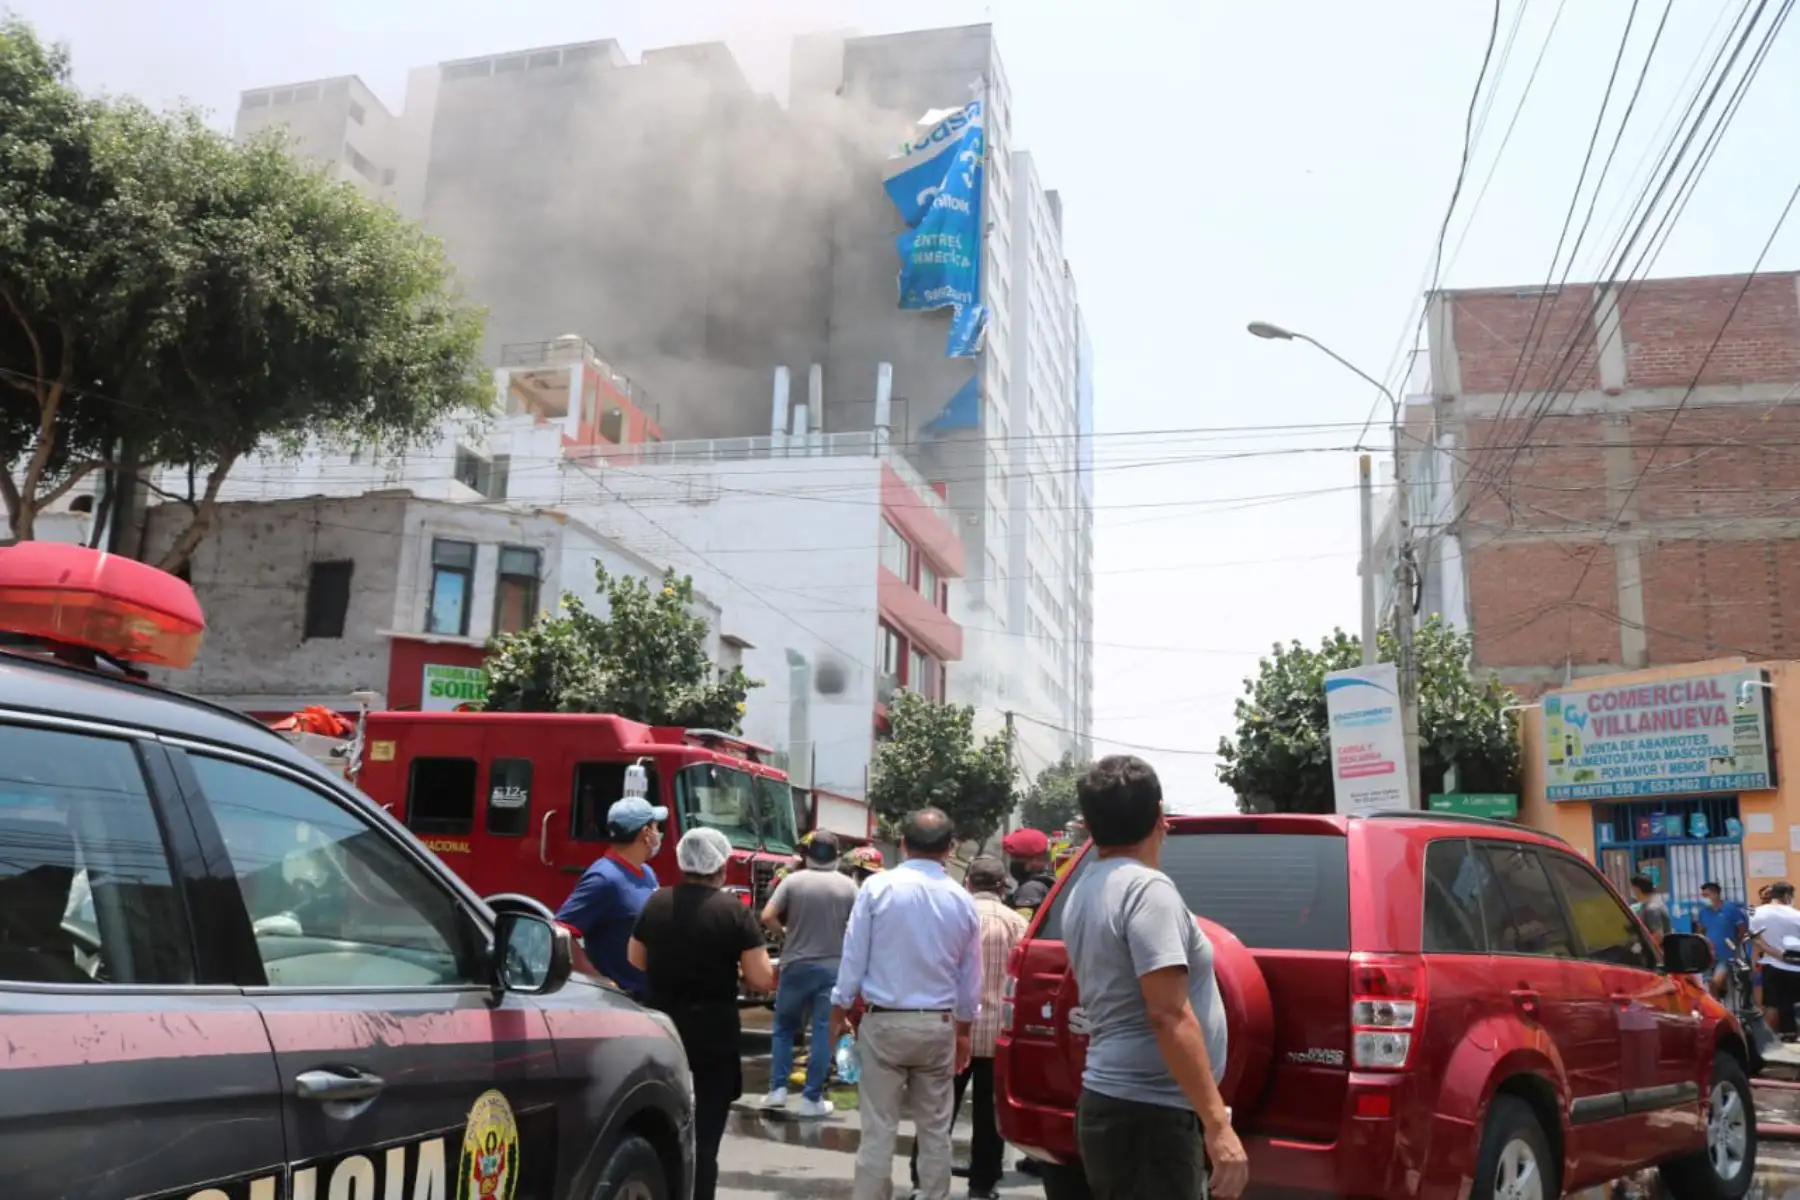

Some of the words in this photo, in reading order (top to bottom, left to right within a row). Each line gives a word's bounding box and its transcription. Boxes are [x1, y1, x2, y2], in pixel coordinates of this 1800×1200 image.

[1587, 679, 1726, 714] COMERCIAL
[1591, 703, 1730, 738] VILLANUEVA
[1584, 741, 1618, 755] VENTA
[1620, 740, 1636, 751] DE
[1637, 734, 1709, 750] ABARROTES
[1568, 753, 1630, 768] ALIMENTOS
[1631, 748, 1661, 761] PARA
[1664, 745, 1729, 760] MASCOTAS
[1601, 767, 1621, 779] POR
[1623, 764, 1658, 778] MAYOR
[1669, 760, 1706, 774] MENOR
